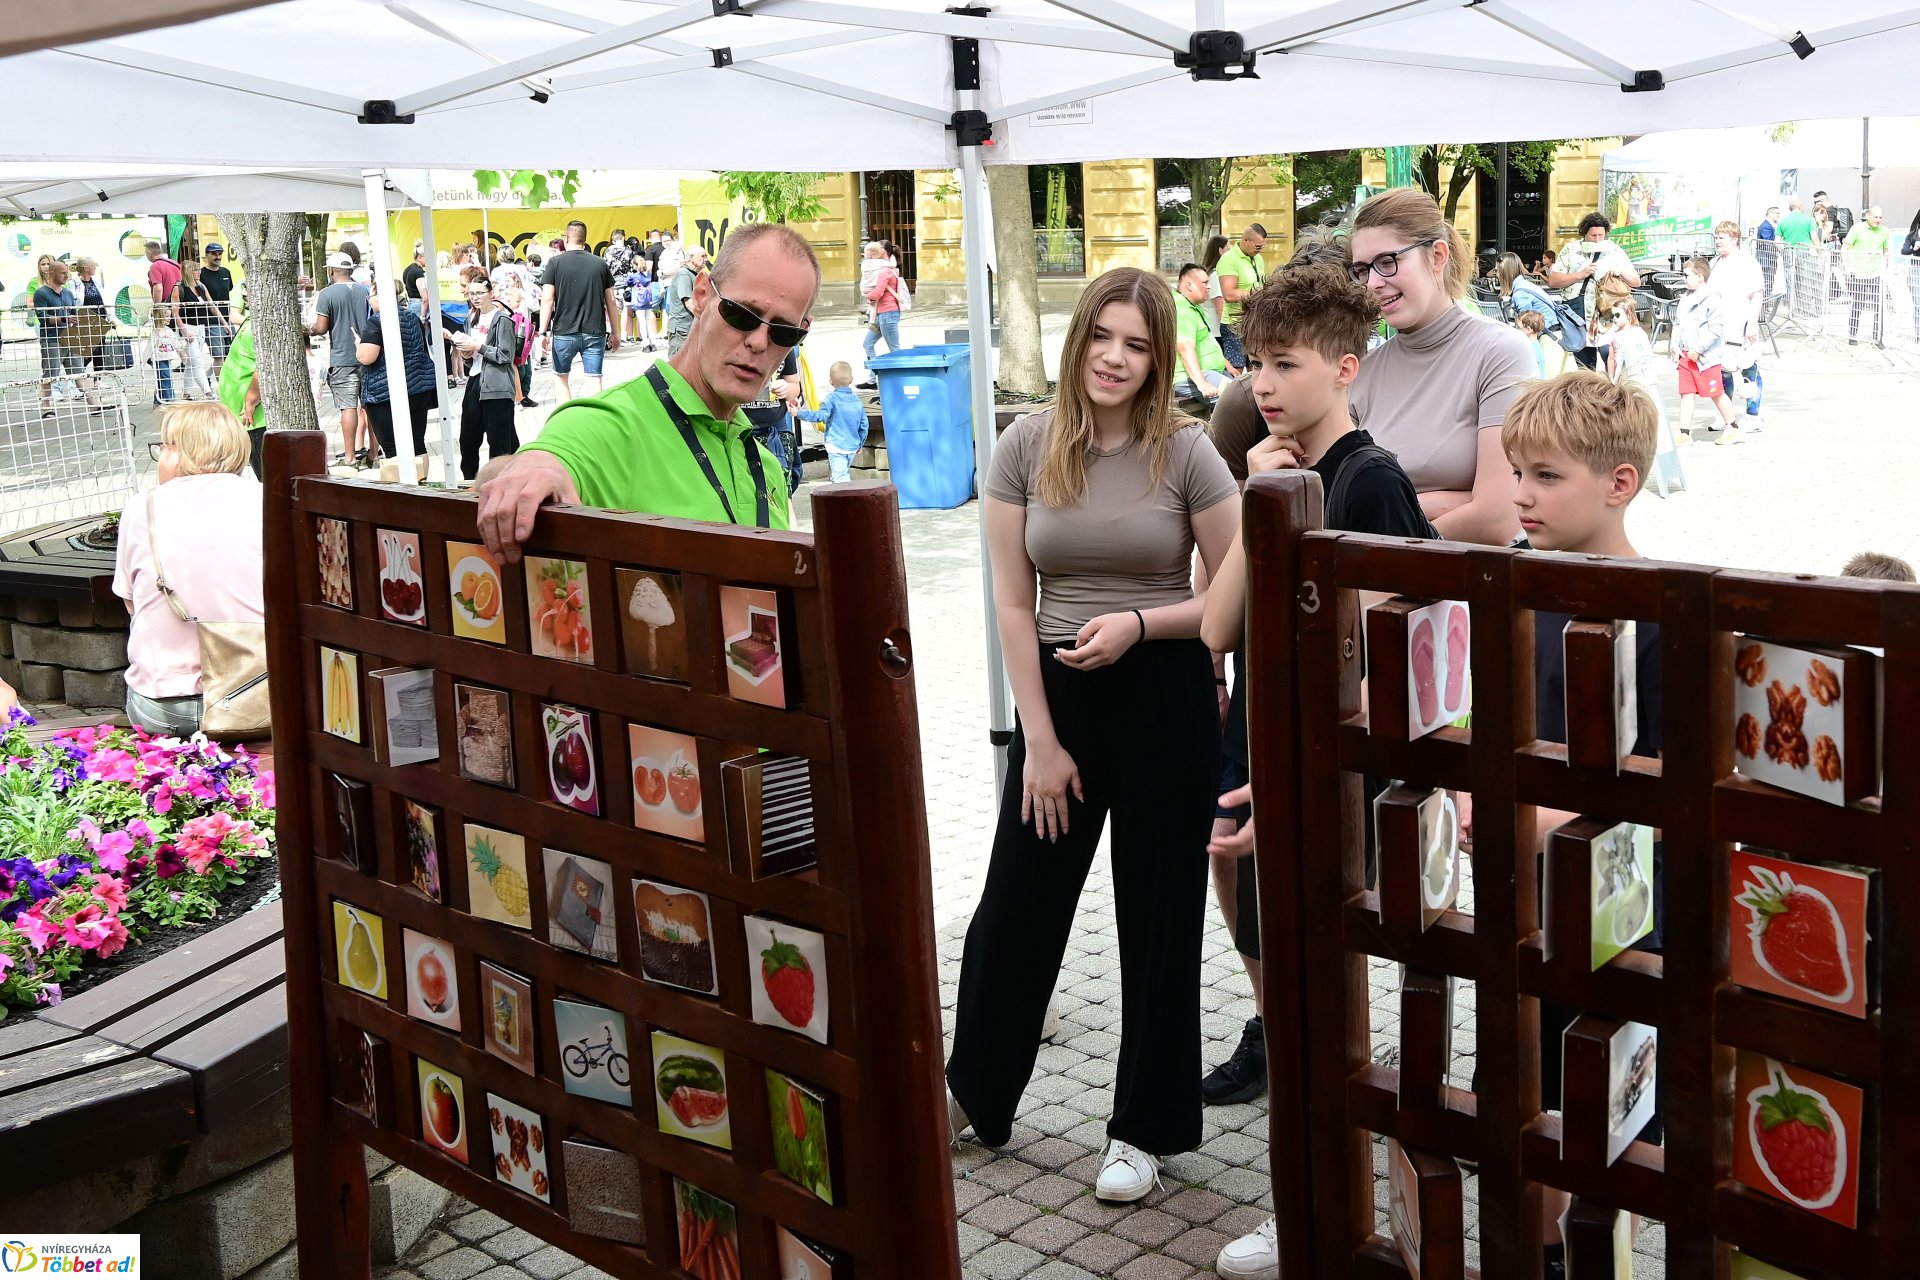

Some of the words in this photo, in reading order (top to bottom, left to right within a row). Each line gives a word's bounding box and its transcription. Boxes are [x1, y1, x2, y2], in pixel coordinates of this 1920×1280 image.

[432, 189, 473, 201] letünk
[290, 479, 300, 502] 1
[793, 550, 808, 575] 2
[1300, 580, 1321, 614] 3
